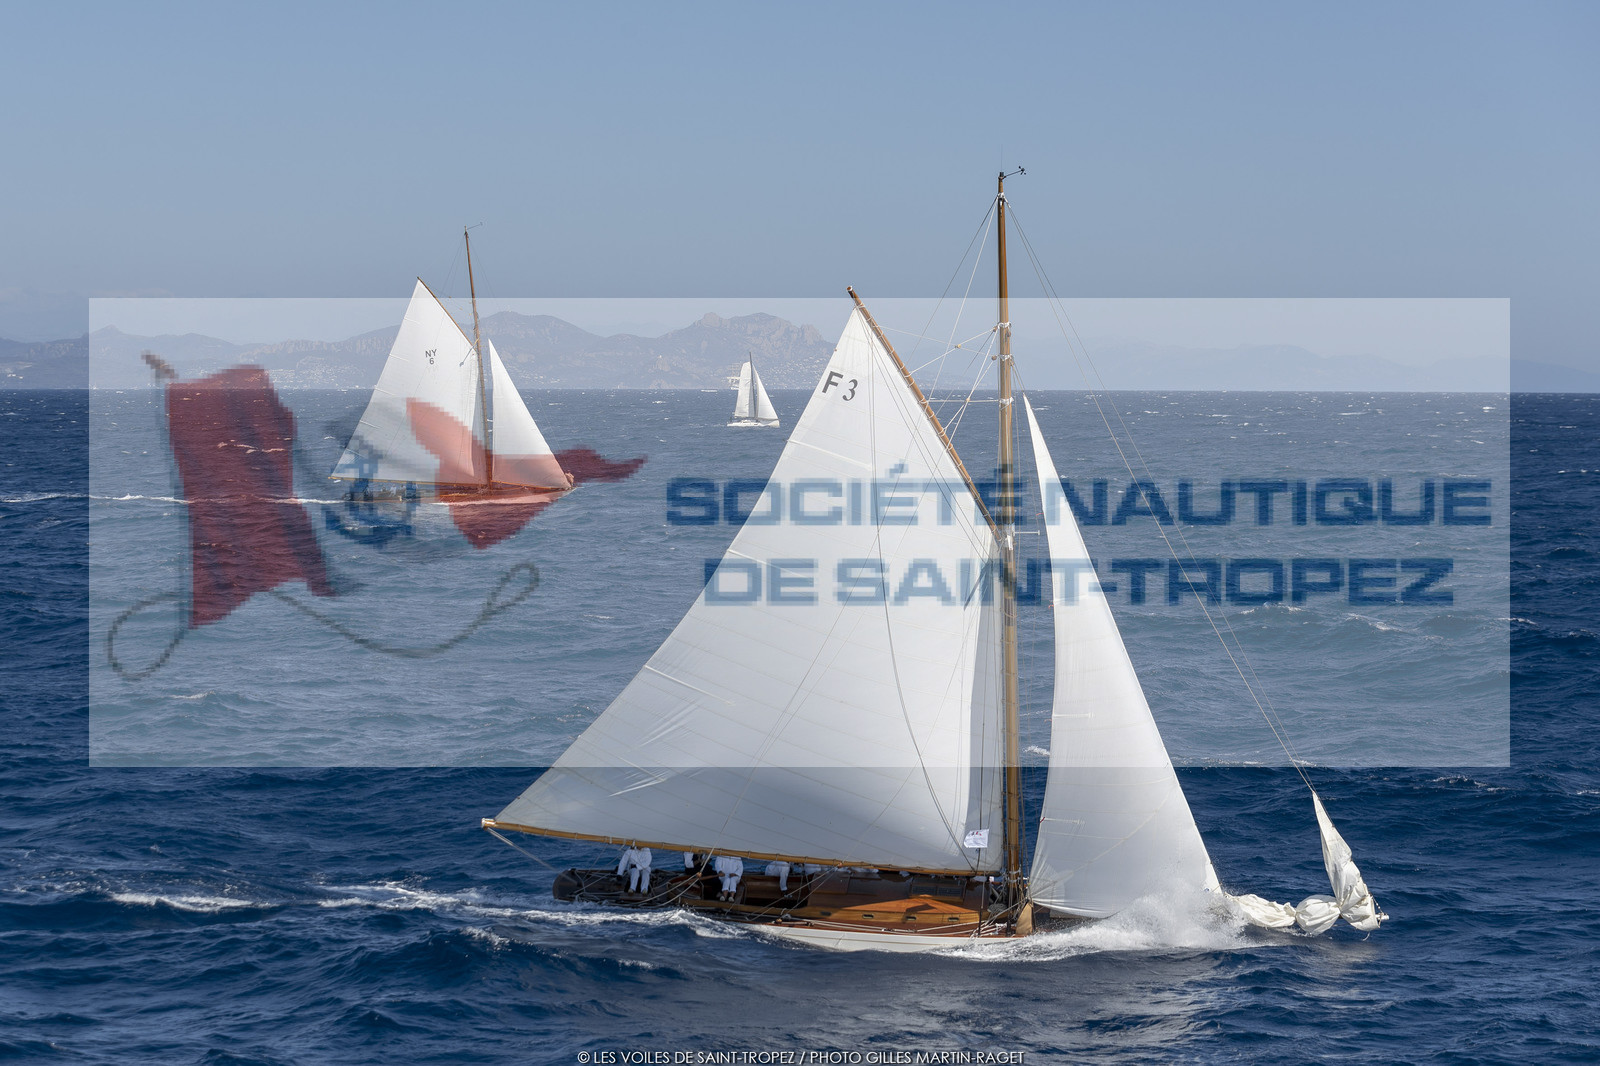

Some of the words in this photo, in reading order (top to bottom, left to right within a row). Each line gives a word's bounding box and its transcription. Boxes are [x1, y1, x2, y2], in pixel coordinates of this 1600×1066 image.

[425, 349, 437, 358] NY
[429, 357, 435, 365] 6
[821, 370, 844, 394] F
[842, 378, 858, 402] 3
